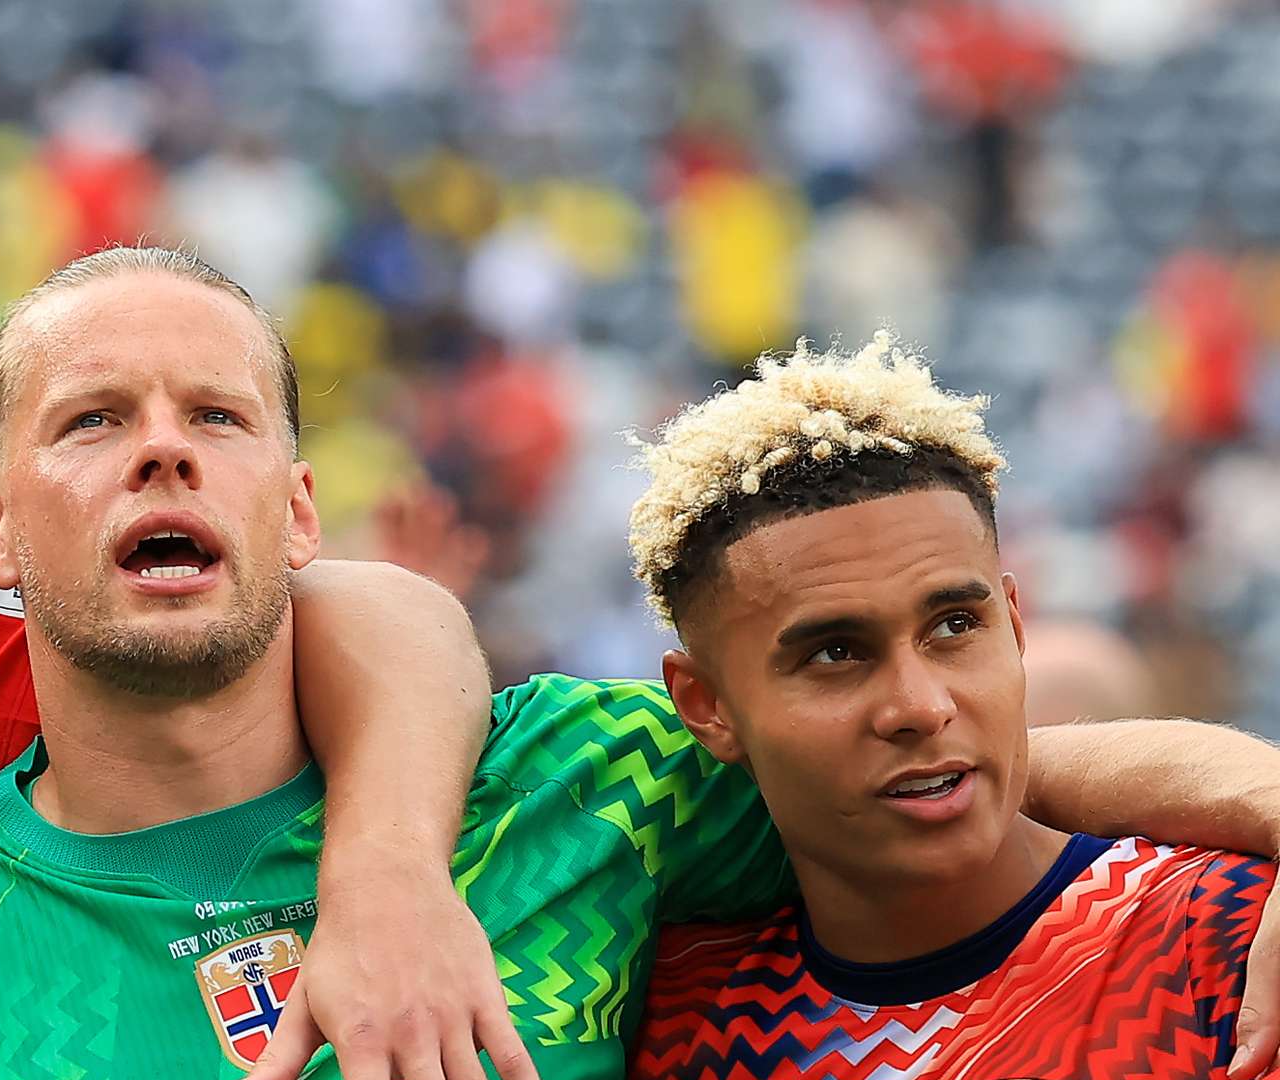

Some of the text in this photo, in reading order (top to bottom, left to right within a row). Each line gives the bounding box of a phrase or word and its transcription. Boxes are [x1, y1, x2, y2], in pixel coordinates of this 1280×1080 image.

[168, 900, 319, 960] NEW YORK NEW JERS
[228, 942, 265, 965] NORGE
